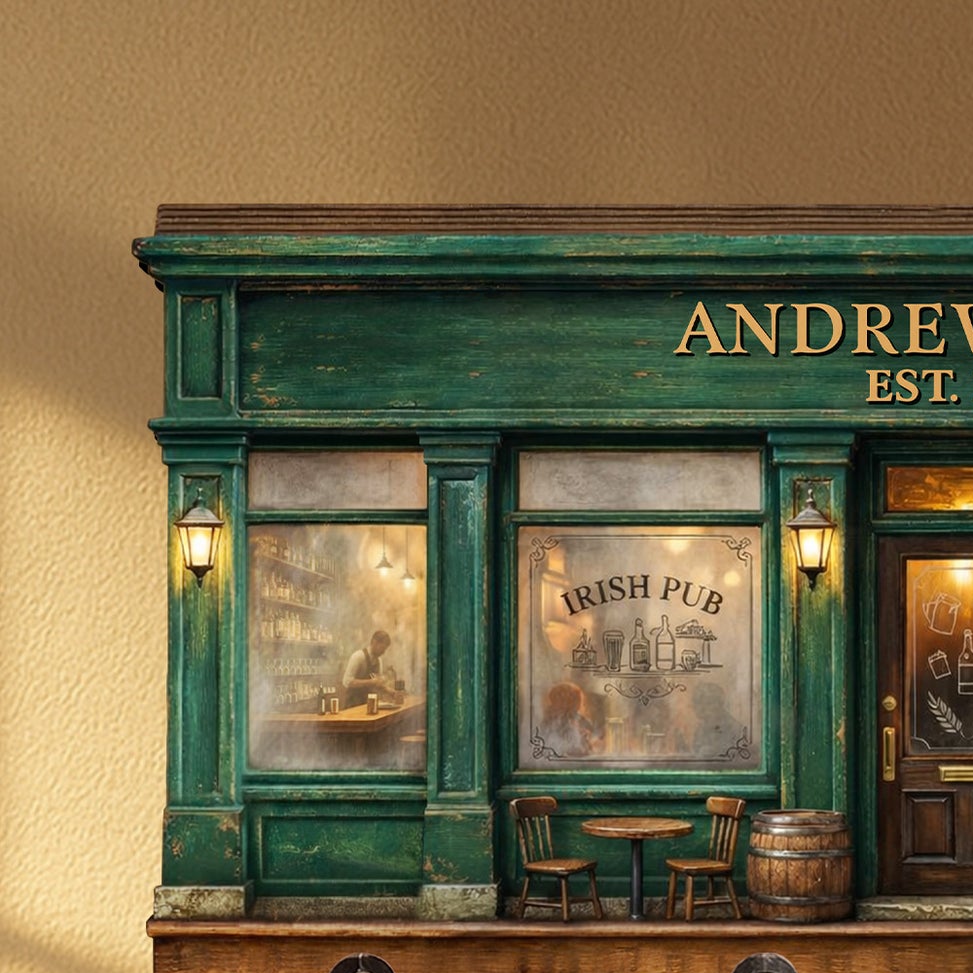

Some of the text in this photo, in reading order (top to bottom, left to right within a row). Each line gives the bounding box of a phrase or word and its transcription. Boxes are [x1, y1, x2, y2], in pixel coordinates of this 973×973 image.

[866, 368, 960, 404] EST.
[560, 574, 724, 616] IRISH PUB
